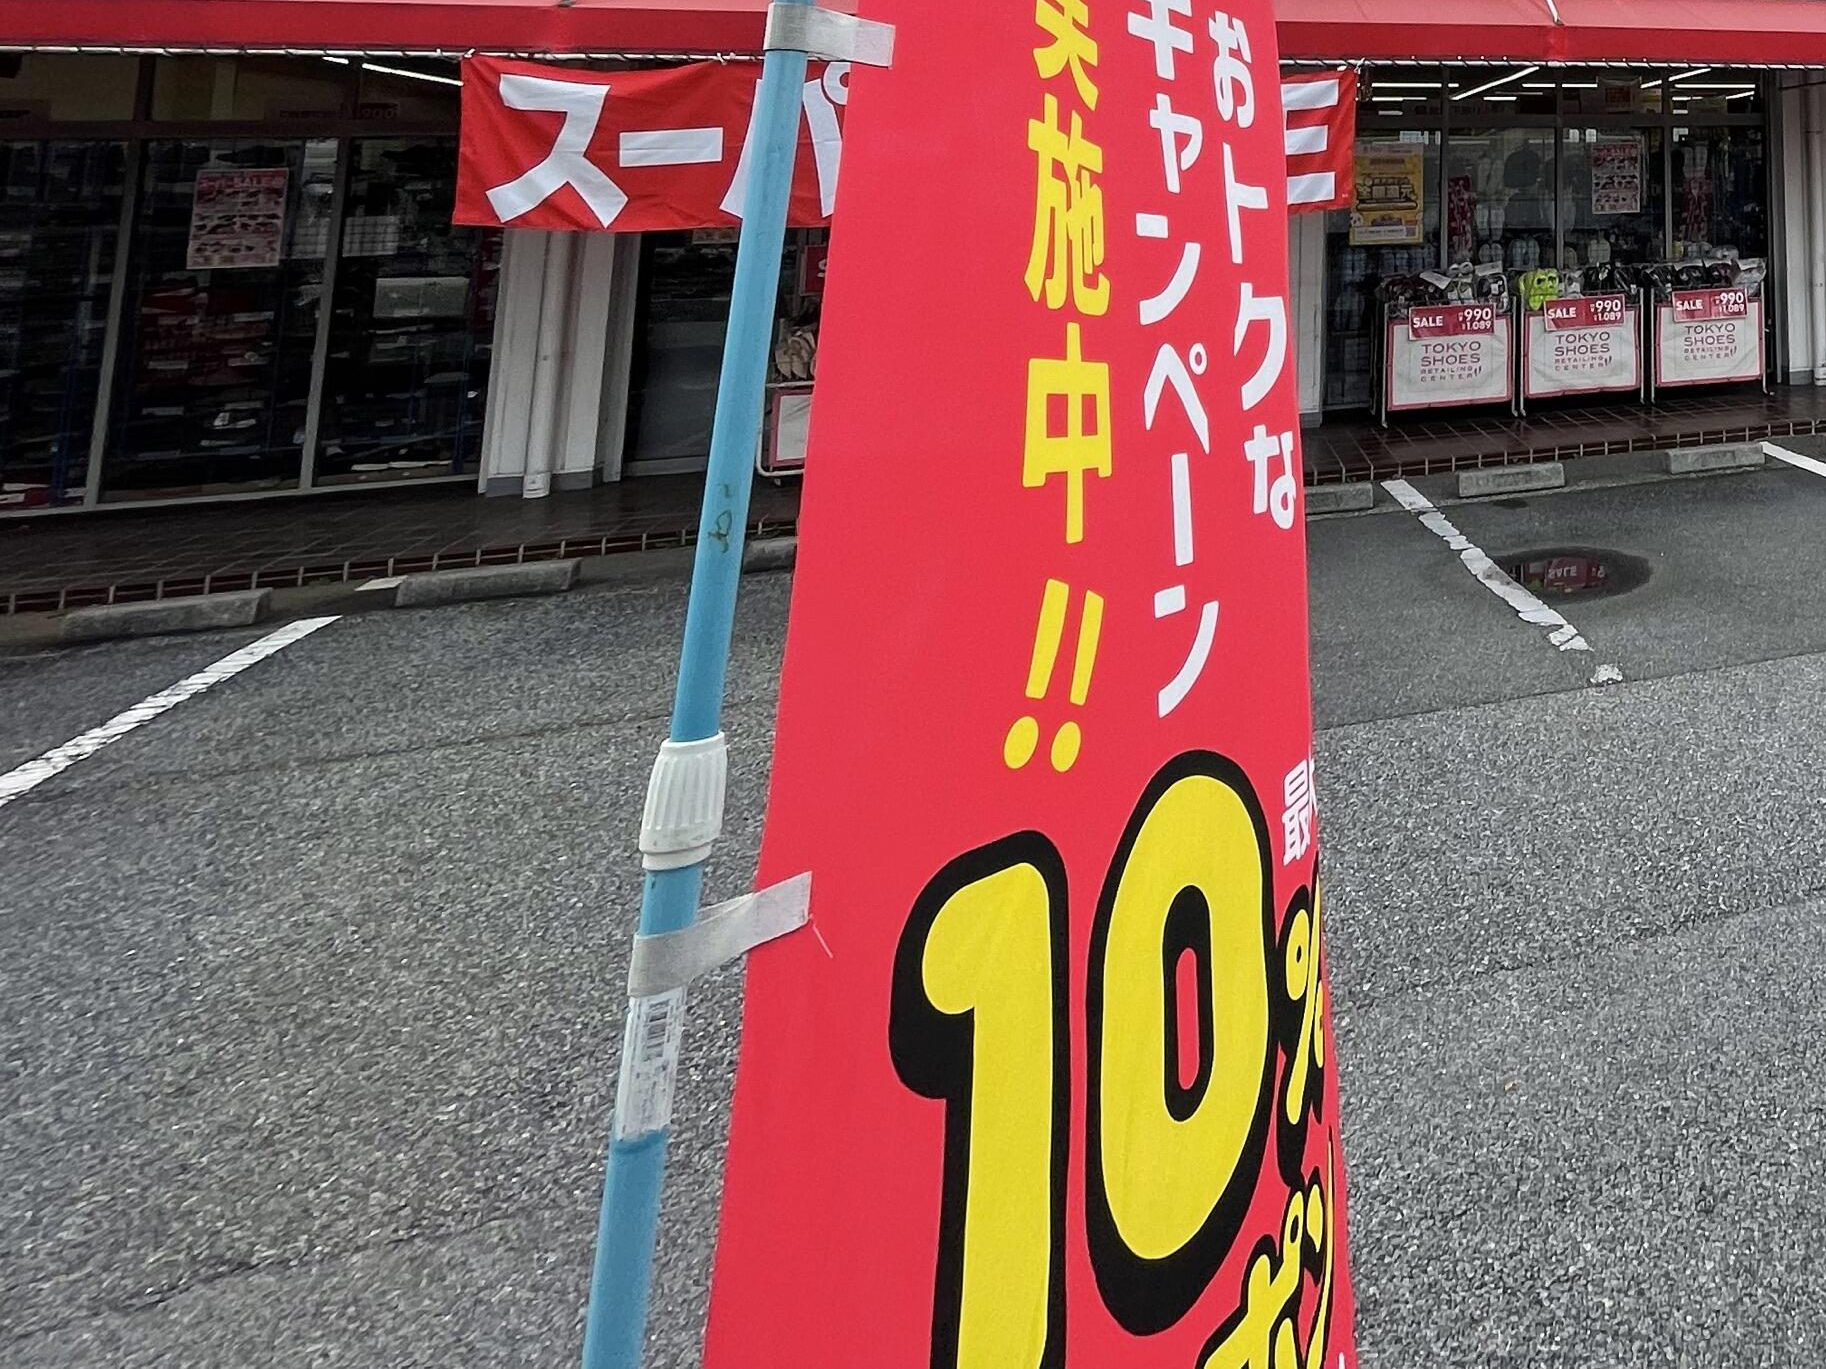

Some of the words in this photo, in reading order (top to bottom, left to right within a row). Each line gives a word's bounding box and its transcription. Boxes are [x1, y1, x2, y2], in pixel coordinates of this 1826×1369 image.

[1676, 299, 1703, 311] SALE
[1548, 307, 1576, 319] SALE
[1413, 316, 1443, 328] SALE
[1685, 323, 1736, 335] TOKYO
[1554, 332, 1610, 344] TOKYO
[1684, 334, 1736, 347] SHOES
[1421, 341, 1481, 354] TOKYO
[1554, 343, 1610, 357] SHOES
[1421, 353, 1481, 367] SHOES
